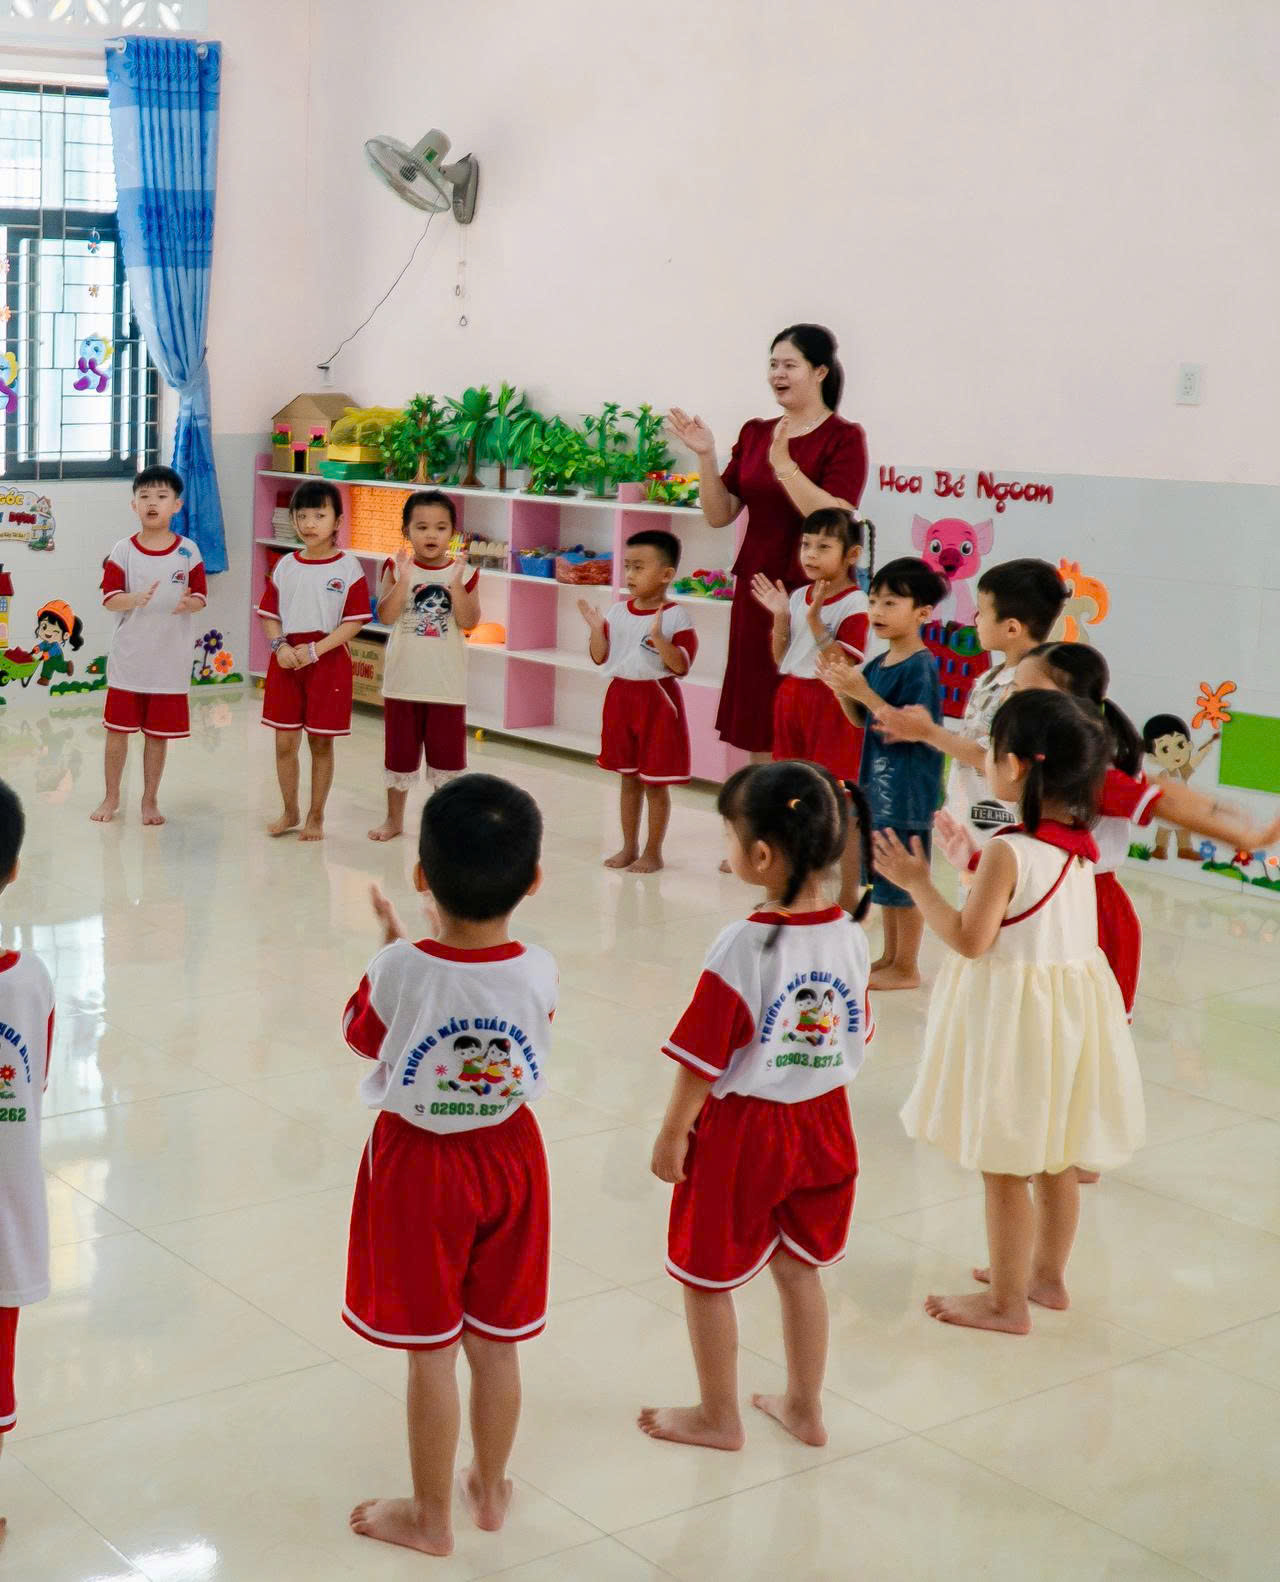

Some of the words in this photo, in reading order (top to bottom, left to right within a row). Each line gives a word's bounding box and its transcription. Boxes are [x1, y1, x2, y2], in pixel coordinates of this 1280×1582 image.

[879, 465, 923, 494] Hoa
[934, 470, 966, 498] Bé
[977, 471, 1054, 513] Ngoan
[832, 977, 851, 999] HOA
[475, 1016, 507, 1032] GIÁO
[509, 1024, 528, 1046] HOA
